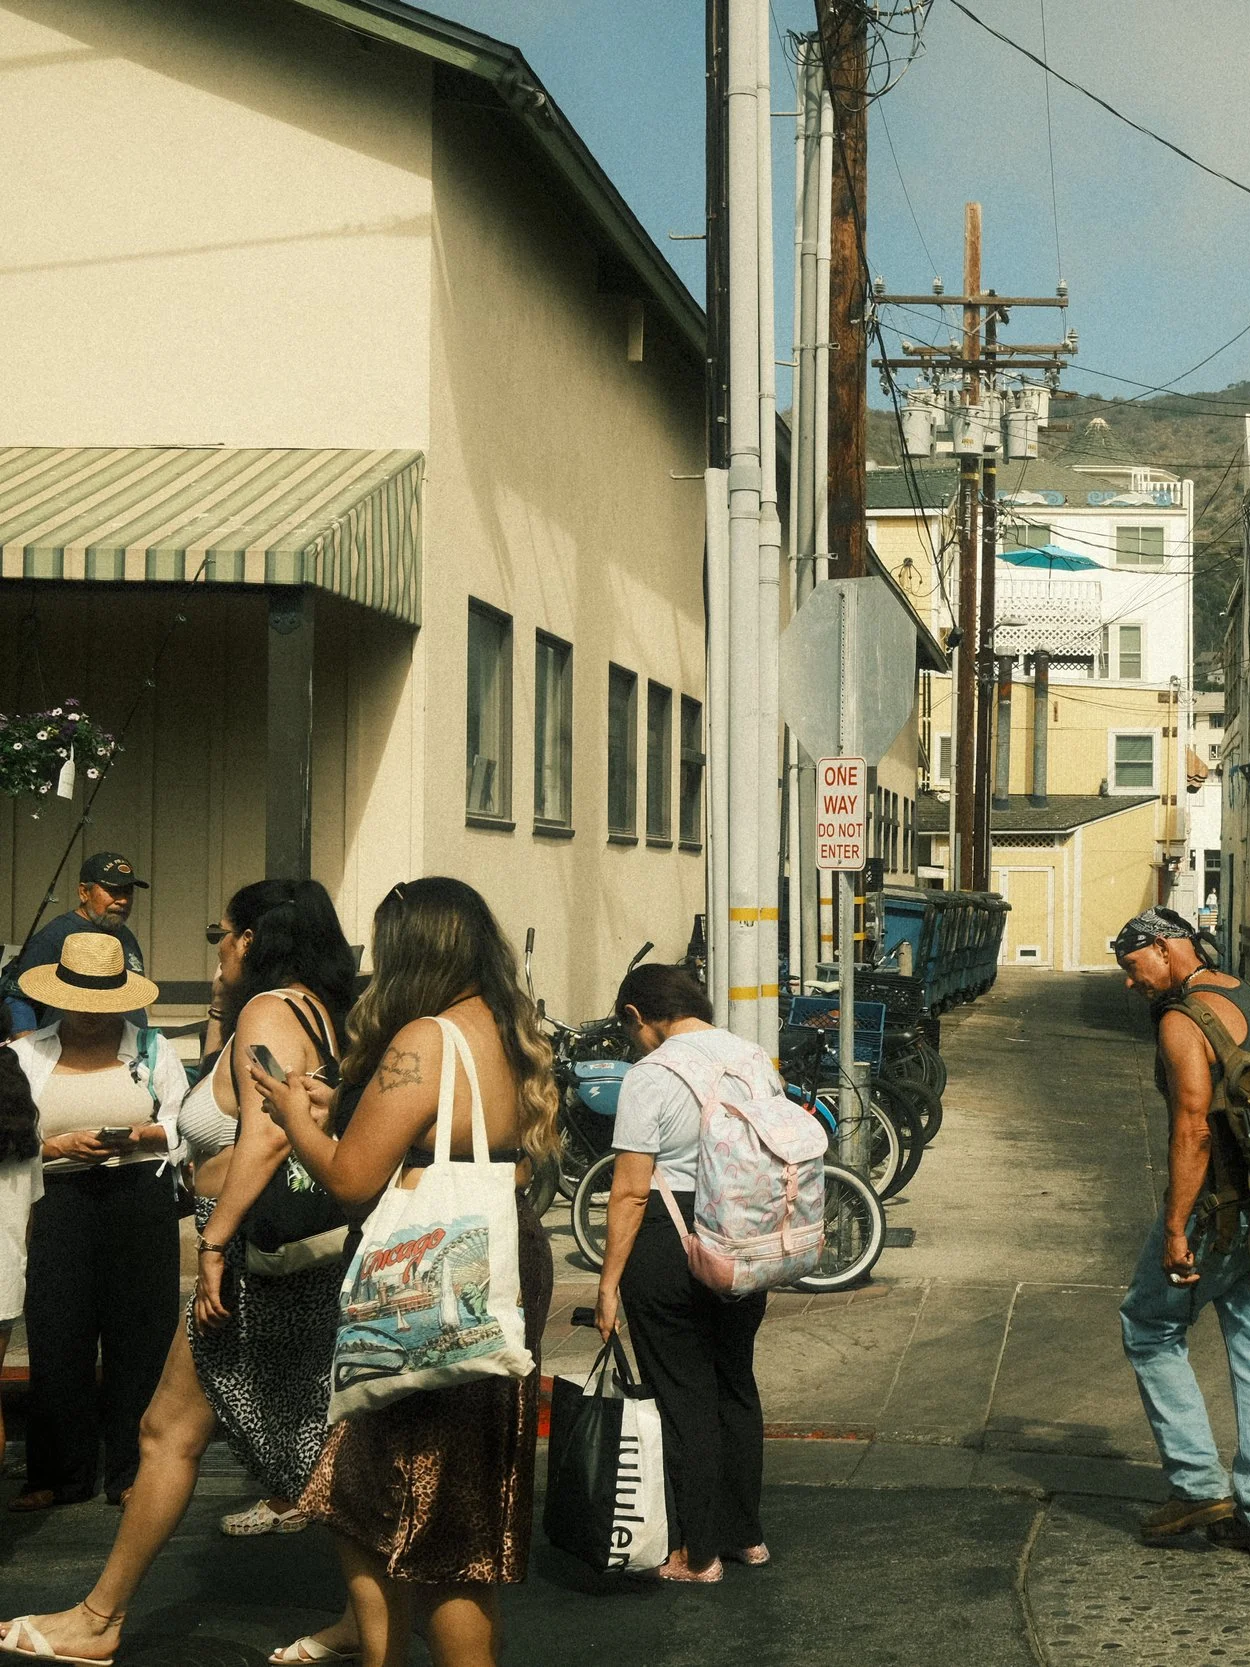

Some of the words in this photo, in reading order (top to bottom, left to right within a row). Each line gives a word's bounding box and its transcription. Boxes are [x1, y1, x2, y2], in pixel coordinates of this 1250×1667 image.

[824, 766, 858, 787] ONE
[823, 795, 858, 815] WAY
[818, 823, 835, 838] DO
[838, 823, 863, 838] NOT
[821, 844, 860, 859] ENTER
